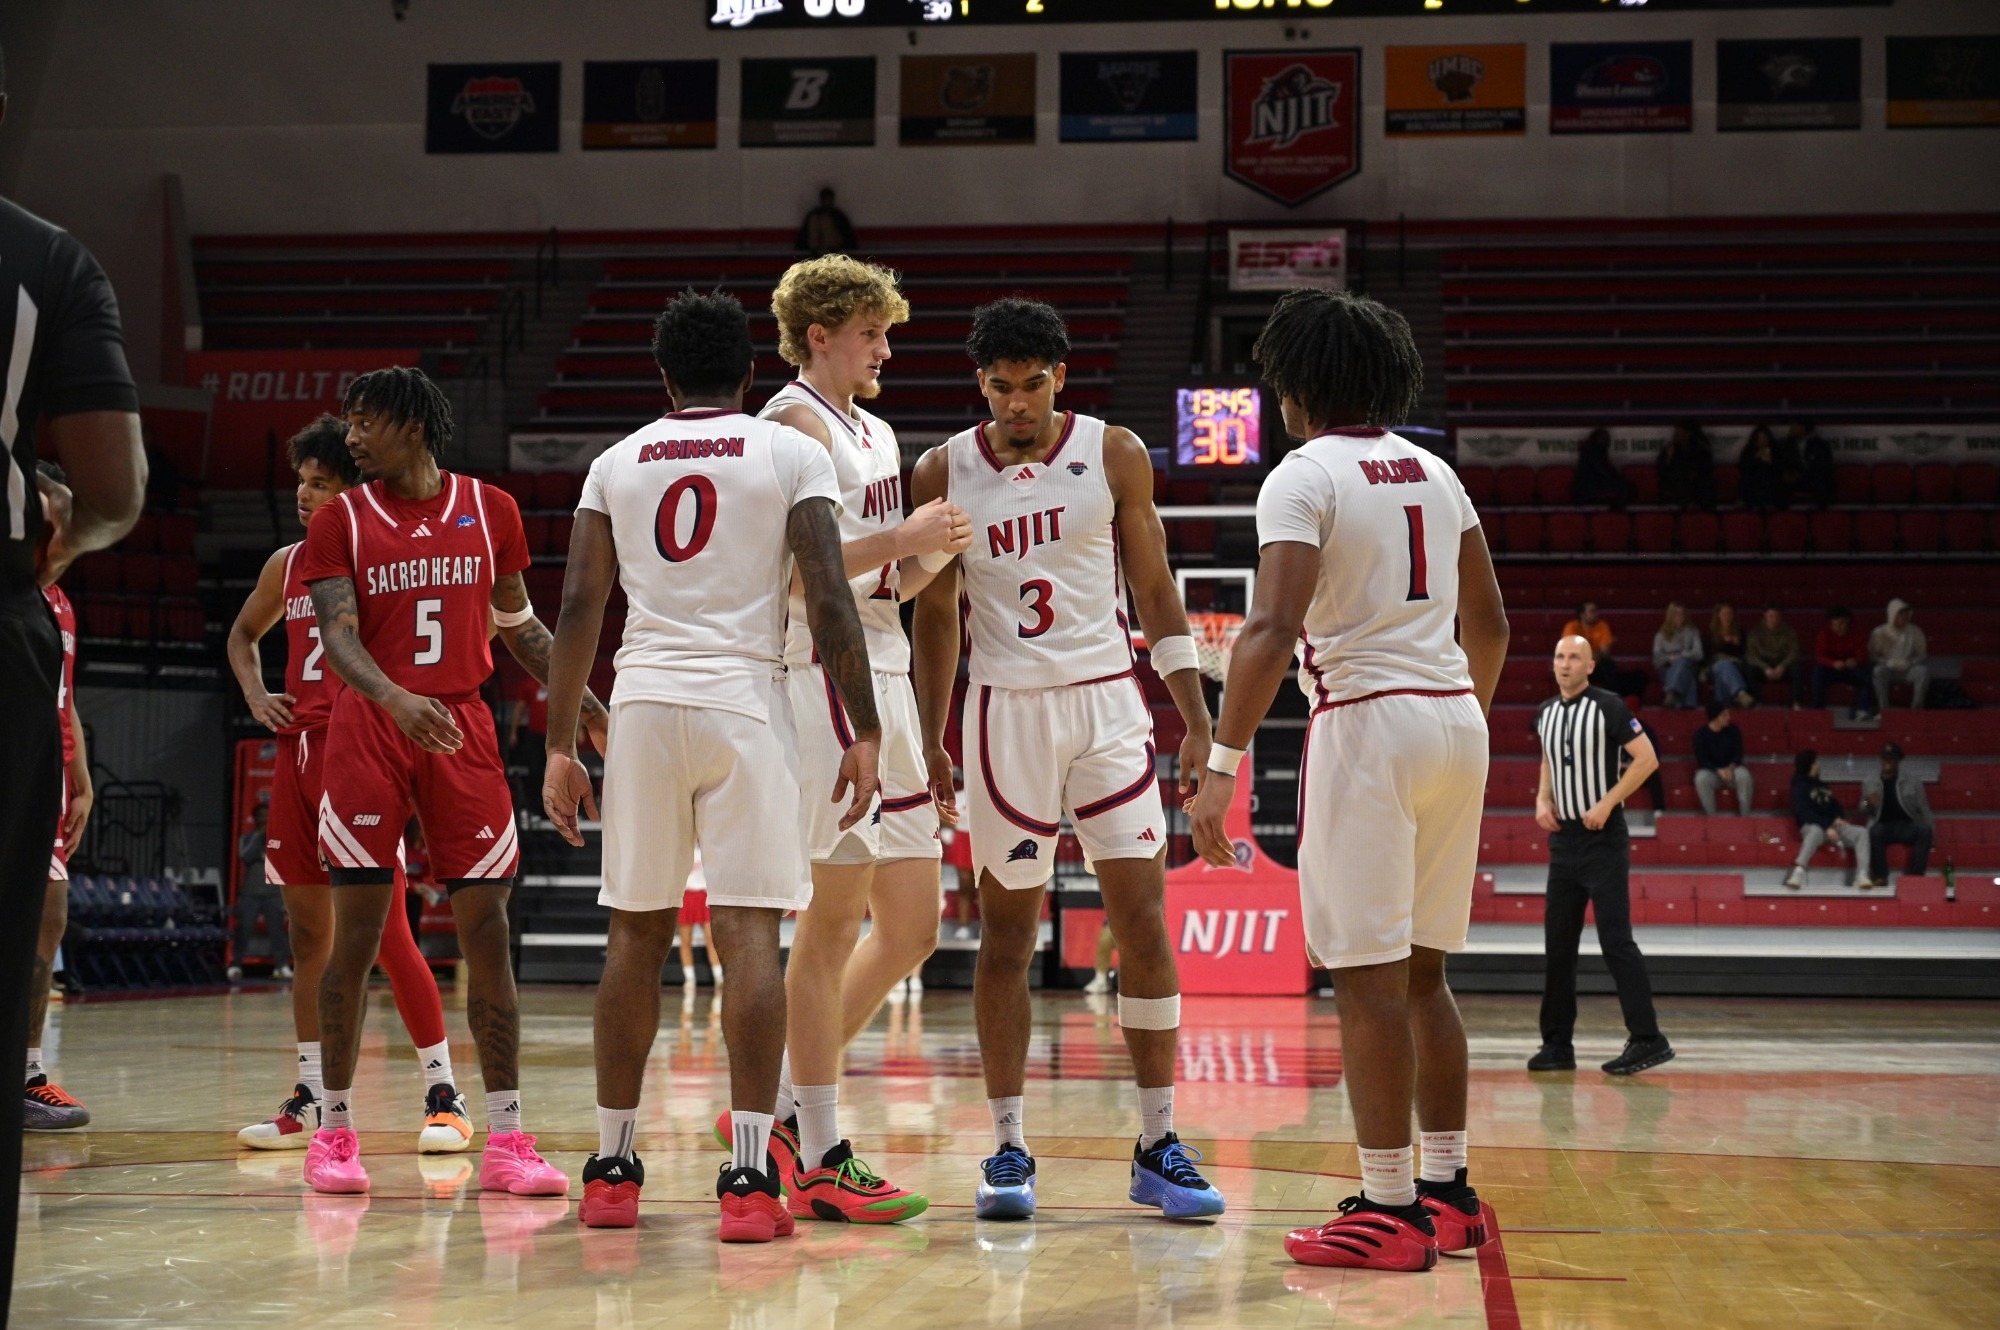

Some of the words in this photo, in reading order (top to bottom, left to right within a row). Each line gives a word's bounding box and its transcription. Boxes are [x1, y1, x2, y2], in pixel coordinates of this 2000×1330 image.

[1428, 56, 1485, 79] UMBC
[784, 68, 830, 110] B
[1257, 91, 1335, 147] NJIT
[1238, 240, 1341, 269] ESPN
[201, 371, 357, 401] #ROLLTE
[1191, 388, 1254, 416] 13:45
[638, 437, 745, 464] ROBINSON
[1193, 417, 1247, 465] 30
[1844, 437, 1879, 450] HERE
[1358, 457, 1429, 485] BOLDEN
[654, 473, 718, 563] 0
[862, 475, 898, 524] NJIT
[987, 505, 1066, 561] NJIT
[1402, 504, 1430, 602] 1
[367, 558, 428, 596] SACRED
[431, 556, 482, 586] HEART
[286, 595, 316, 621] SACRE
[1018, 578, 1055, 639] 3
[414, 598, 443, 666] 5
[352, 813, 381, 826] SHU
[1179, 909, 1289, 960] NJIT
